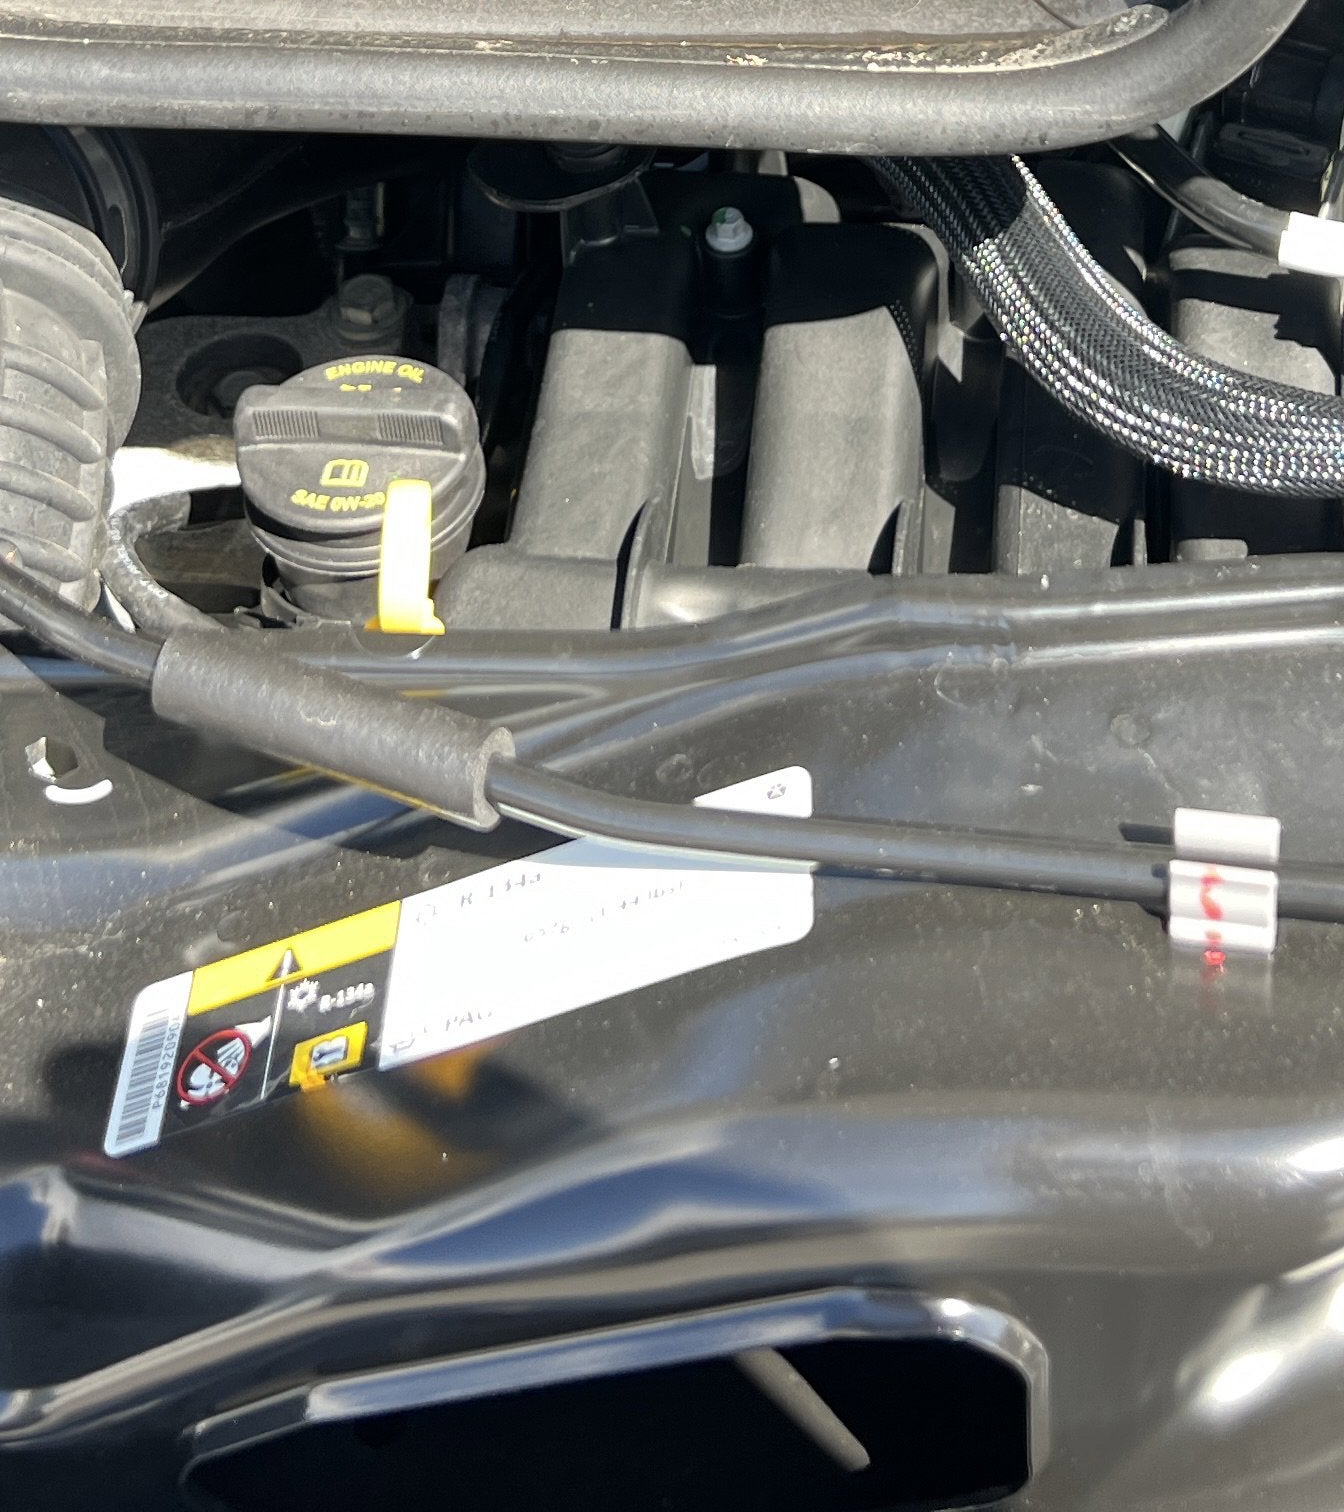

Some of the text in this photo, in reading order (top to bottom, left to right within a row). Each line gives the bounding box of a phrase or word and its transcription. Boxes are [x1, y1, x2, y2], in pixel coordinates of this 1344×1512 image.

[324, 360, 425, 385] ENGINE OIL
[290, 488, 331, 512] SAE
